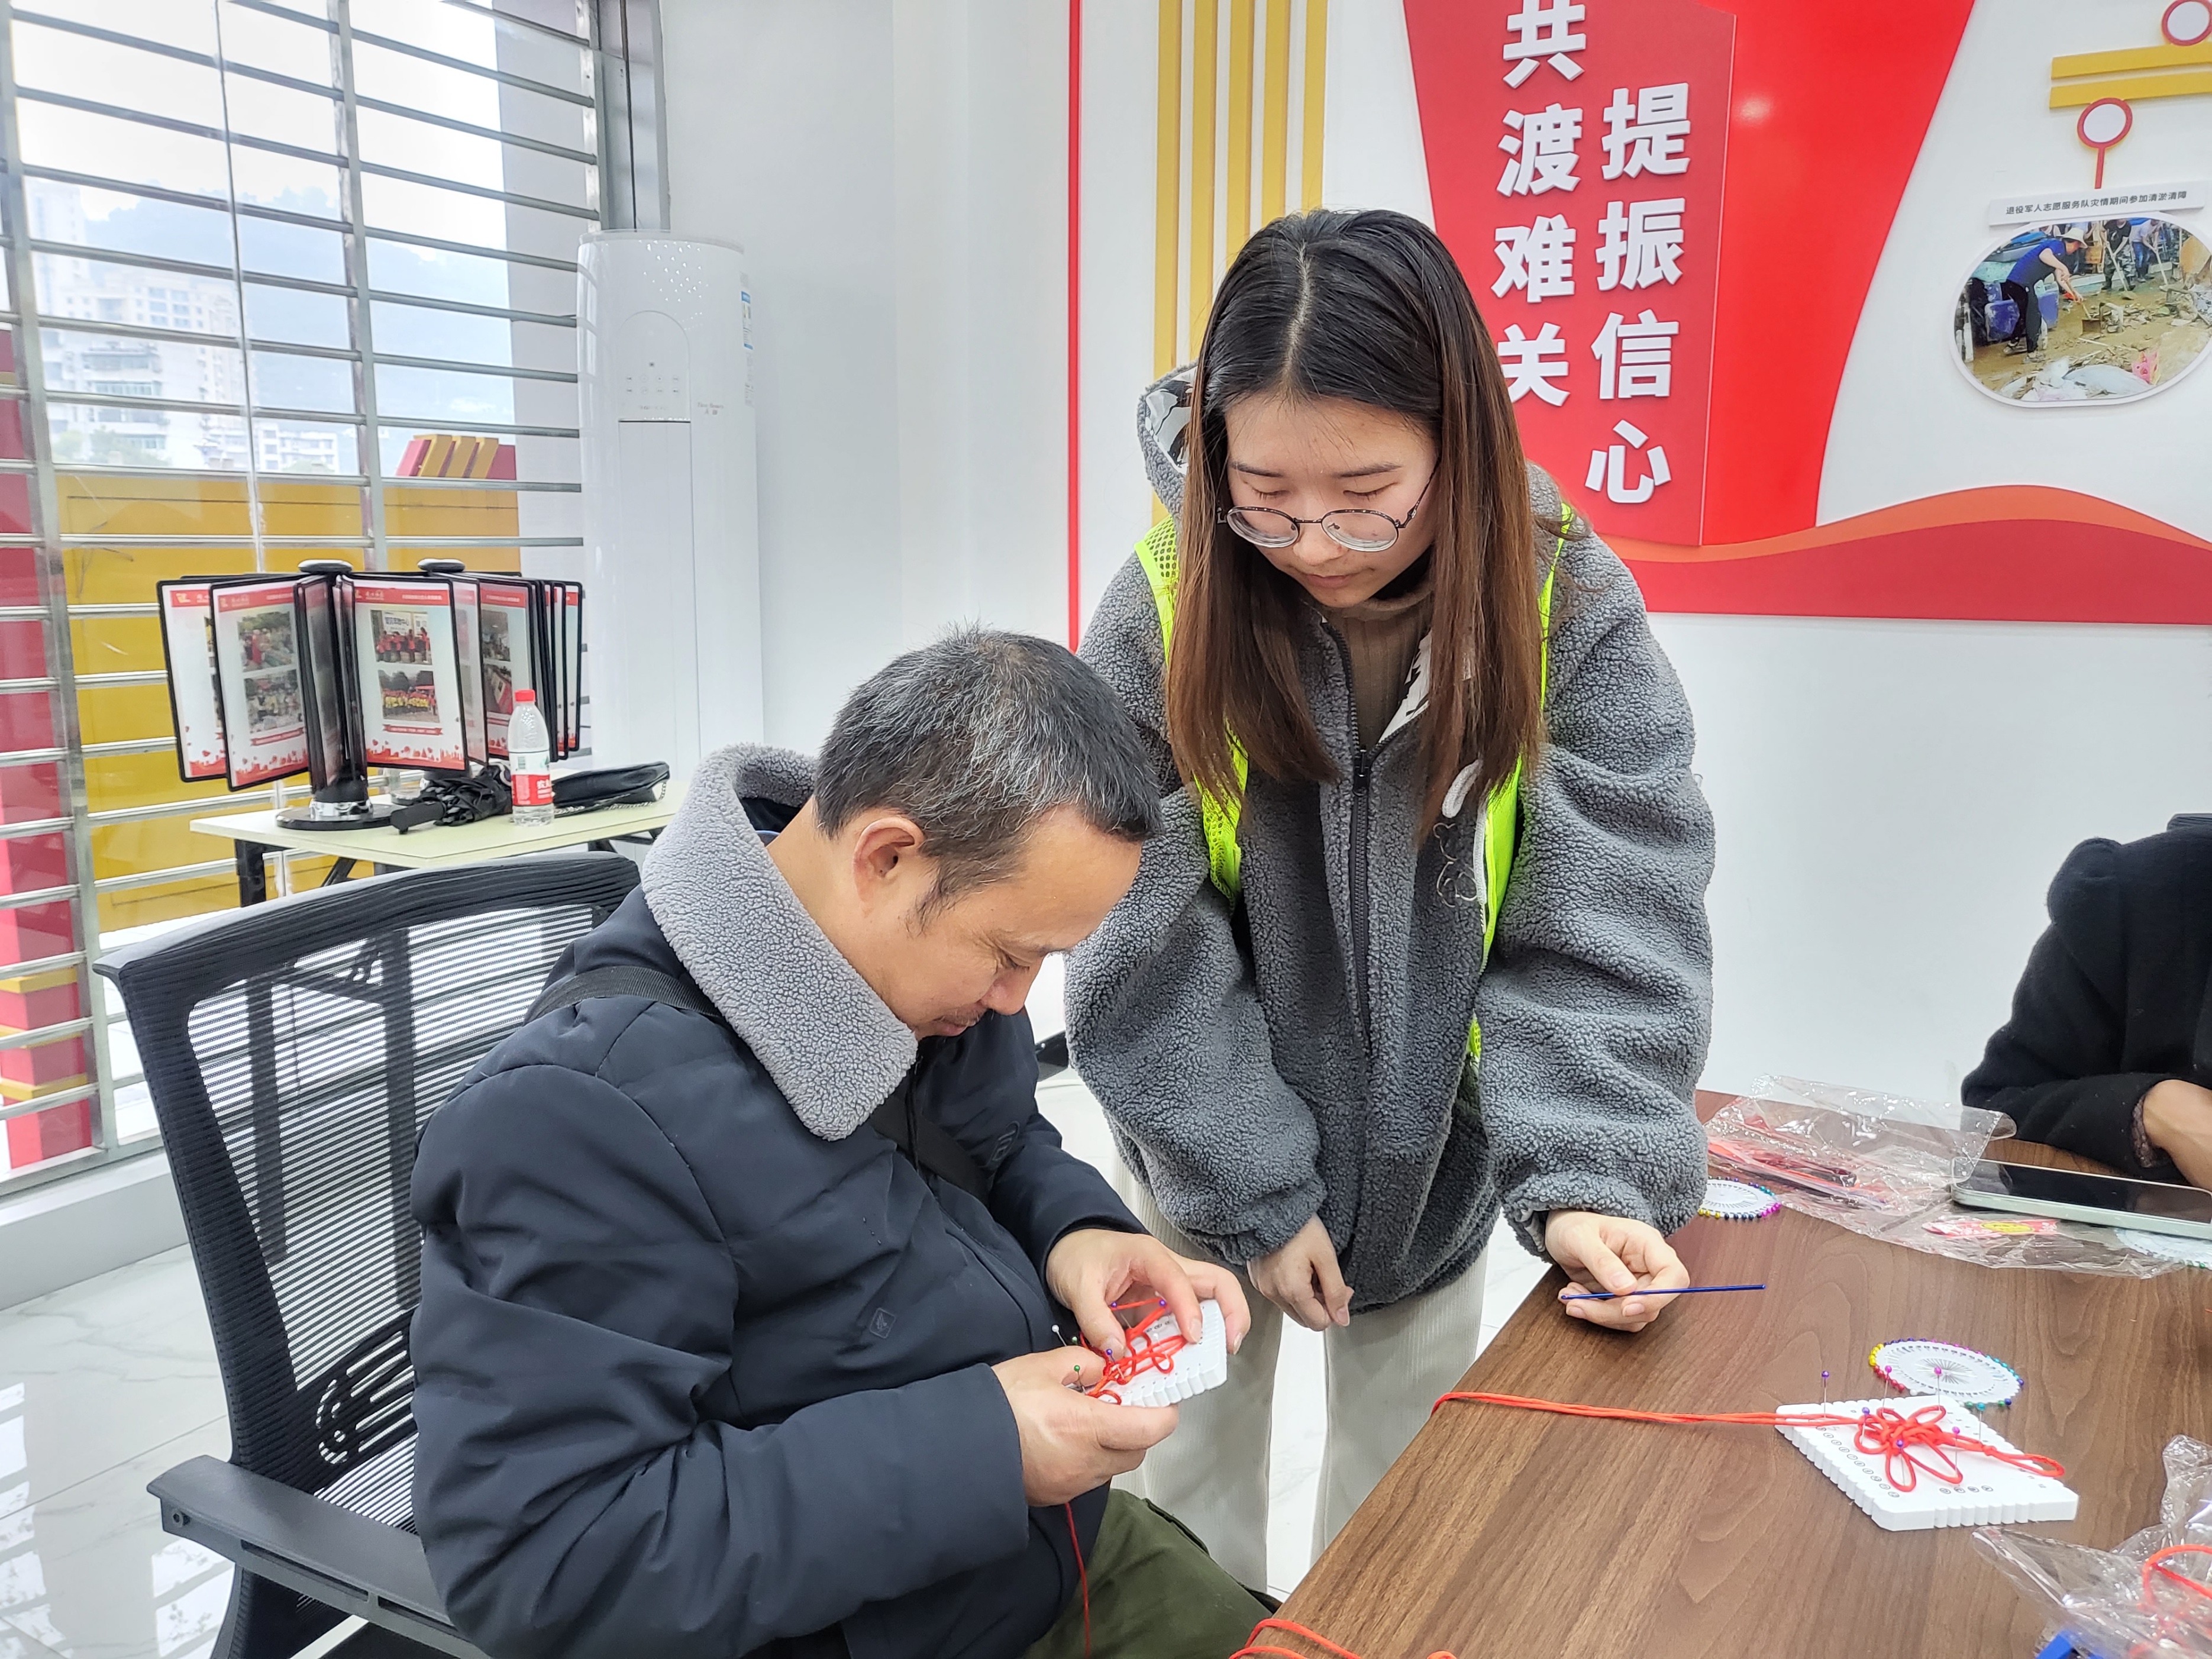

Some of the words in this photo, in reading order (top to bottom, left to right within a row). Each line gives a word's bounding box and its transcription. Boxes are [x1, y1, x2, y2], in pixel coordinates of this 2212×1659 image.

[1491, 0, 1586, 406] 共渡难关
[1585, 82, 1691, 503] 提振信心
[2006, 191, 2187, 215] 退役军人志愿服务队灾情期间参加清淤清障
